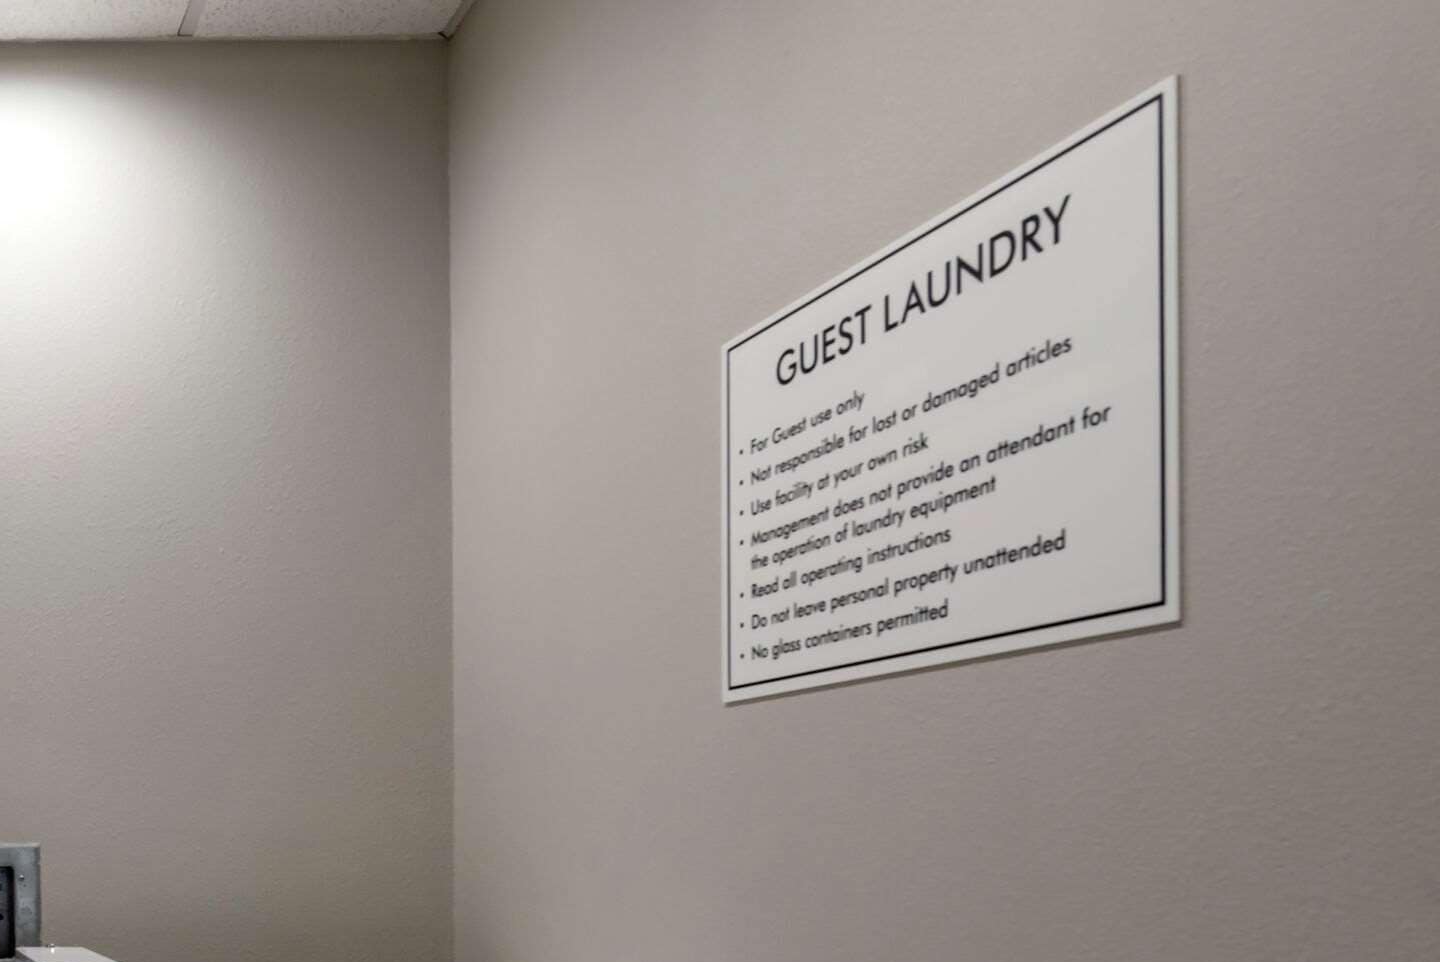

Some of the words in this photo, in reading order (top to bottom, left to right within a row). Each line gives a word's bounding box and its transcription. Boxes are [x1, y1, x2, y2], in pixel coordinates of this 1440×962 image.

[776, 304, 872, 386] GUEST
[883, 194, 1071, 333] LAUNDRY
[750, 465, 771, 484] Not
[775, 433, 845, 475] responsible
[848, 425, 868, 443] for
[872, 410, 897, 434] lost
[901, 404, 918, 421] or
[922, 362, 1000, 412] damaged
[1006, 338, 1073, 377] articles
[750, 438, 768, 454] For
[772, 417, 807, 444] Guest
[810, 408, 832, 427] use
[836, 390, 865, 415] only
[750, 499, 771, 515] Use
[775, 481, 814, 506] facility
[817, 473, 830, 490] at
[833, 462, 863, 488] your
[867, 449, 898, 471] own
[902, 432, 929, 458] risk
[750, 507, 829, 546] Management
[833, 496, 864, 518] does
[869, 483, 892, 504] not
[896, 461, 954, 500] provide
[959, 454, 981, 473] an
[986, 416, 1075, 464] attendant
[1082, 406, 1111, 430] for
[750, 554, 768, 570] the
[772, 534, 831, 566] operation
[834, 522, 848, 543] of
[852, 509, 905, 538] laundry
[910, 475, 997, 518] equipment
[751, 576, 779, 598] Read
[782, 570, 798, 590] all
[800, 556, 863, 586] operating
[867, 528, 952, 565] instructions
[751, 613, 768, 630] Do
[770, 608, 790, 625] not
[793, 602, 827, 618] leave
[830, 577, 889, 613] personal
[893, 563, 959, 597] property
[963, 528, 1067, 575] unattended
[751, 645, 769, 660] No
[772, 637, 802, 660] glass
[805, 622, 873, 649] containers
[876, 598, 949, 637] permitted
